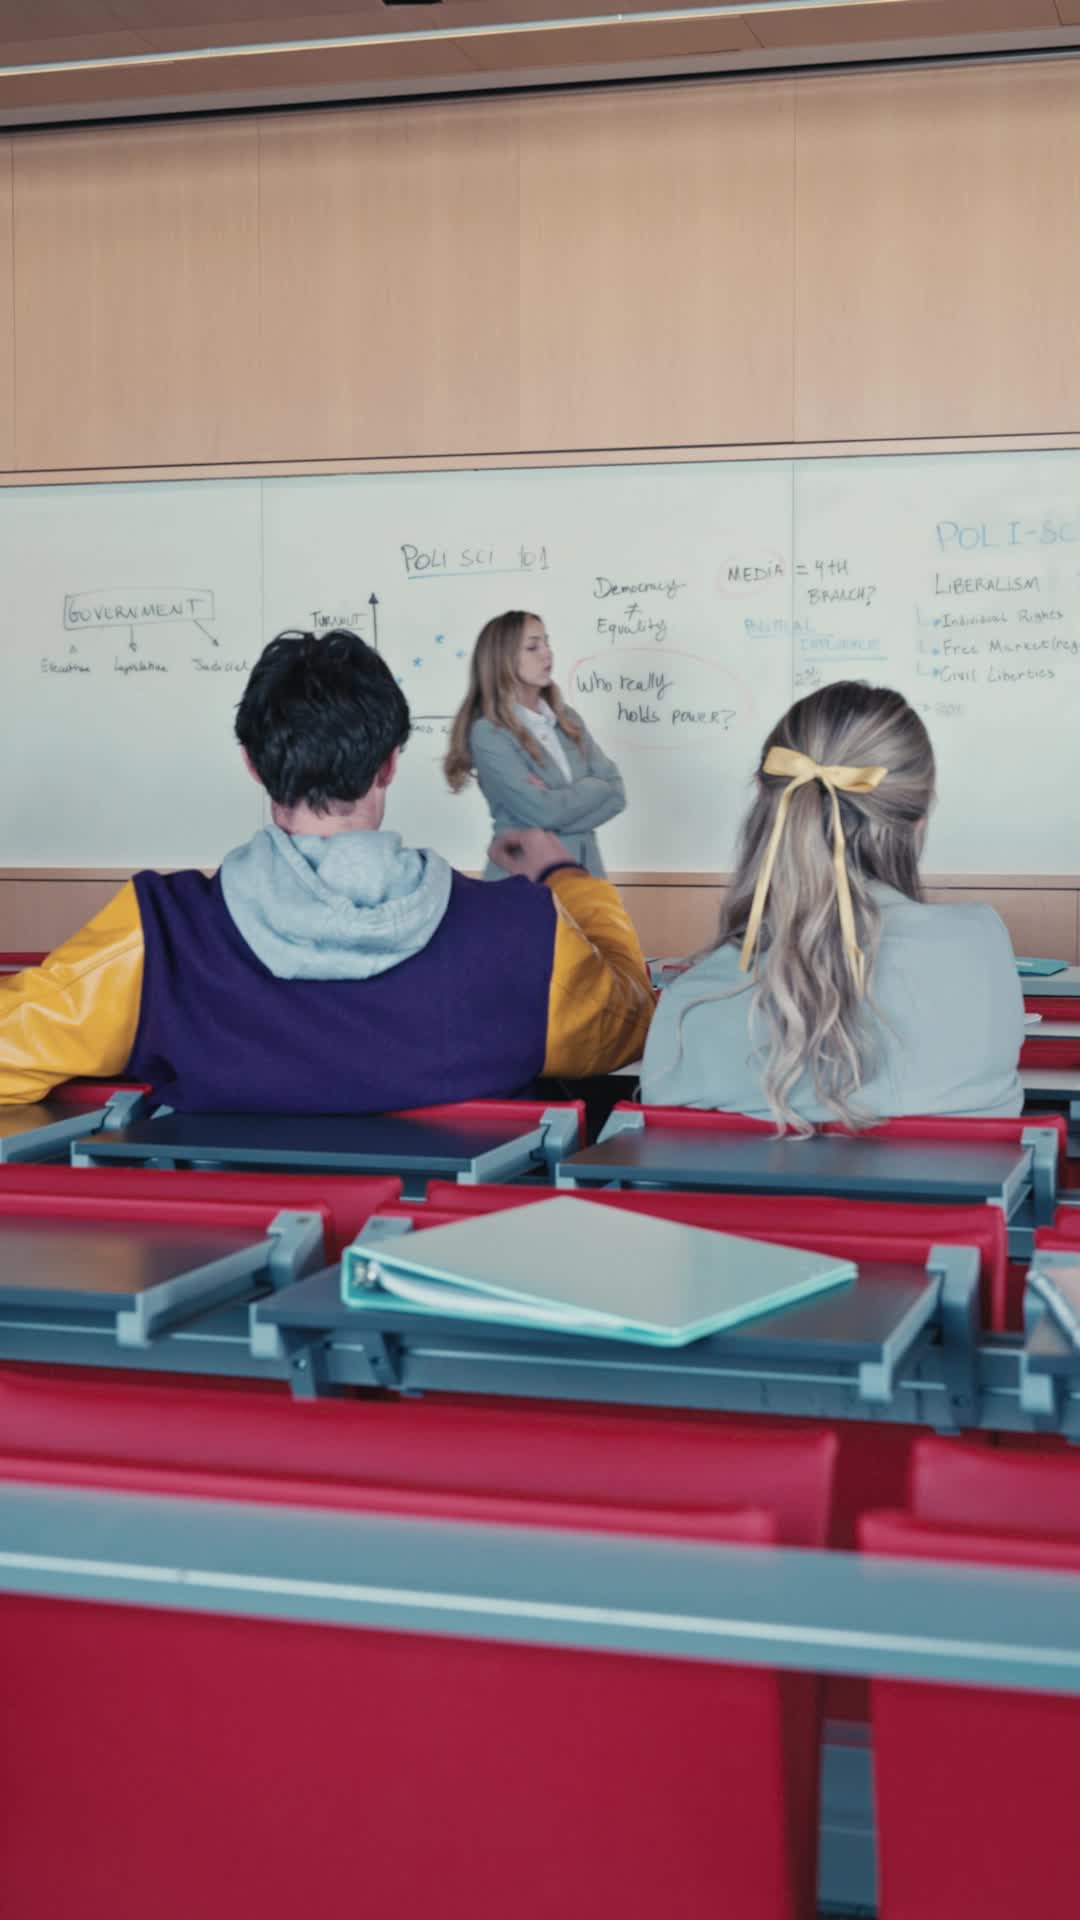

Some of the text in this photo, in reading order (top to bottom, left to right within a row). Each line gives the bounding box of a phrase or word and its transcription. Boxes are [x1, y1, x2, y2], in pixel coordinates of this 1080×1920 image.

[593, 576, 687, 600] Democracy
[68, 599, 203, 622] GOVERNMENT
[942, 608, 1064, 628] Individual Rights
[596, 618, 667, 642] Equality
[943, 639, 978, 656] Free
[987, 665, 1055, 683] Liberties
[577, 672, 673, 701] Who really
[617, 702, 660, 724] holds
